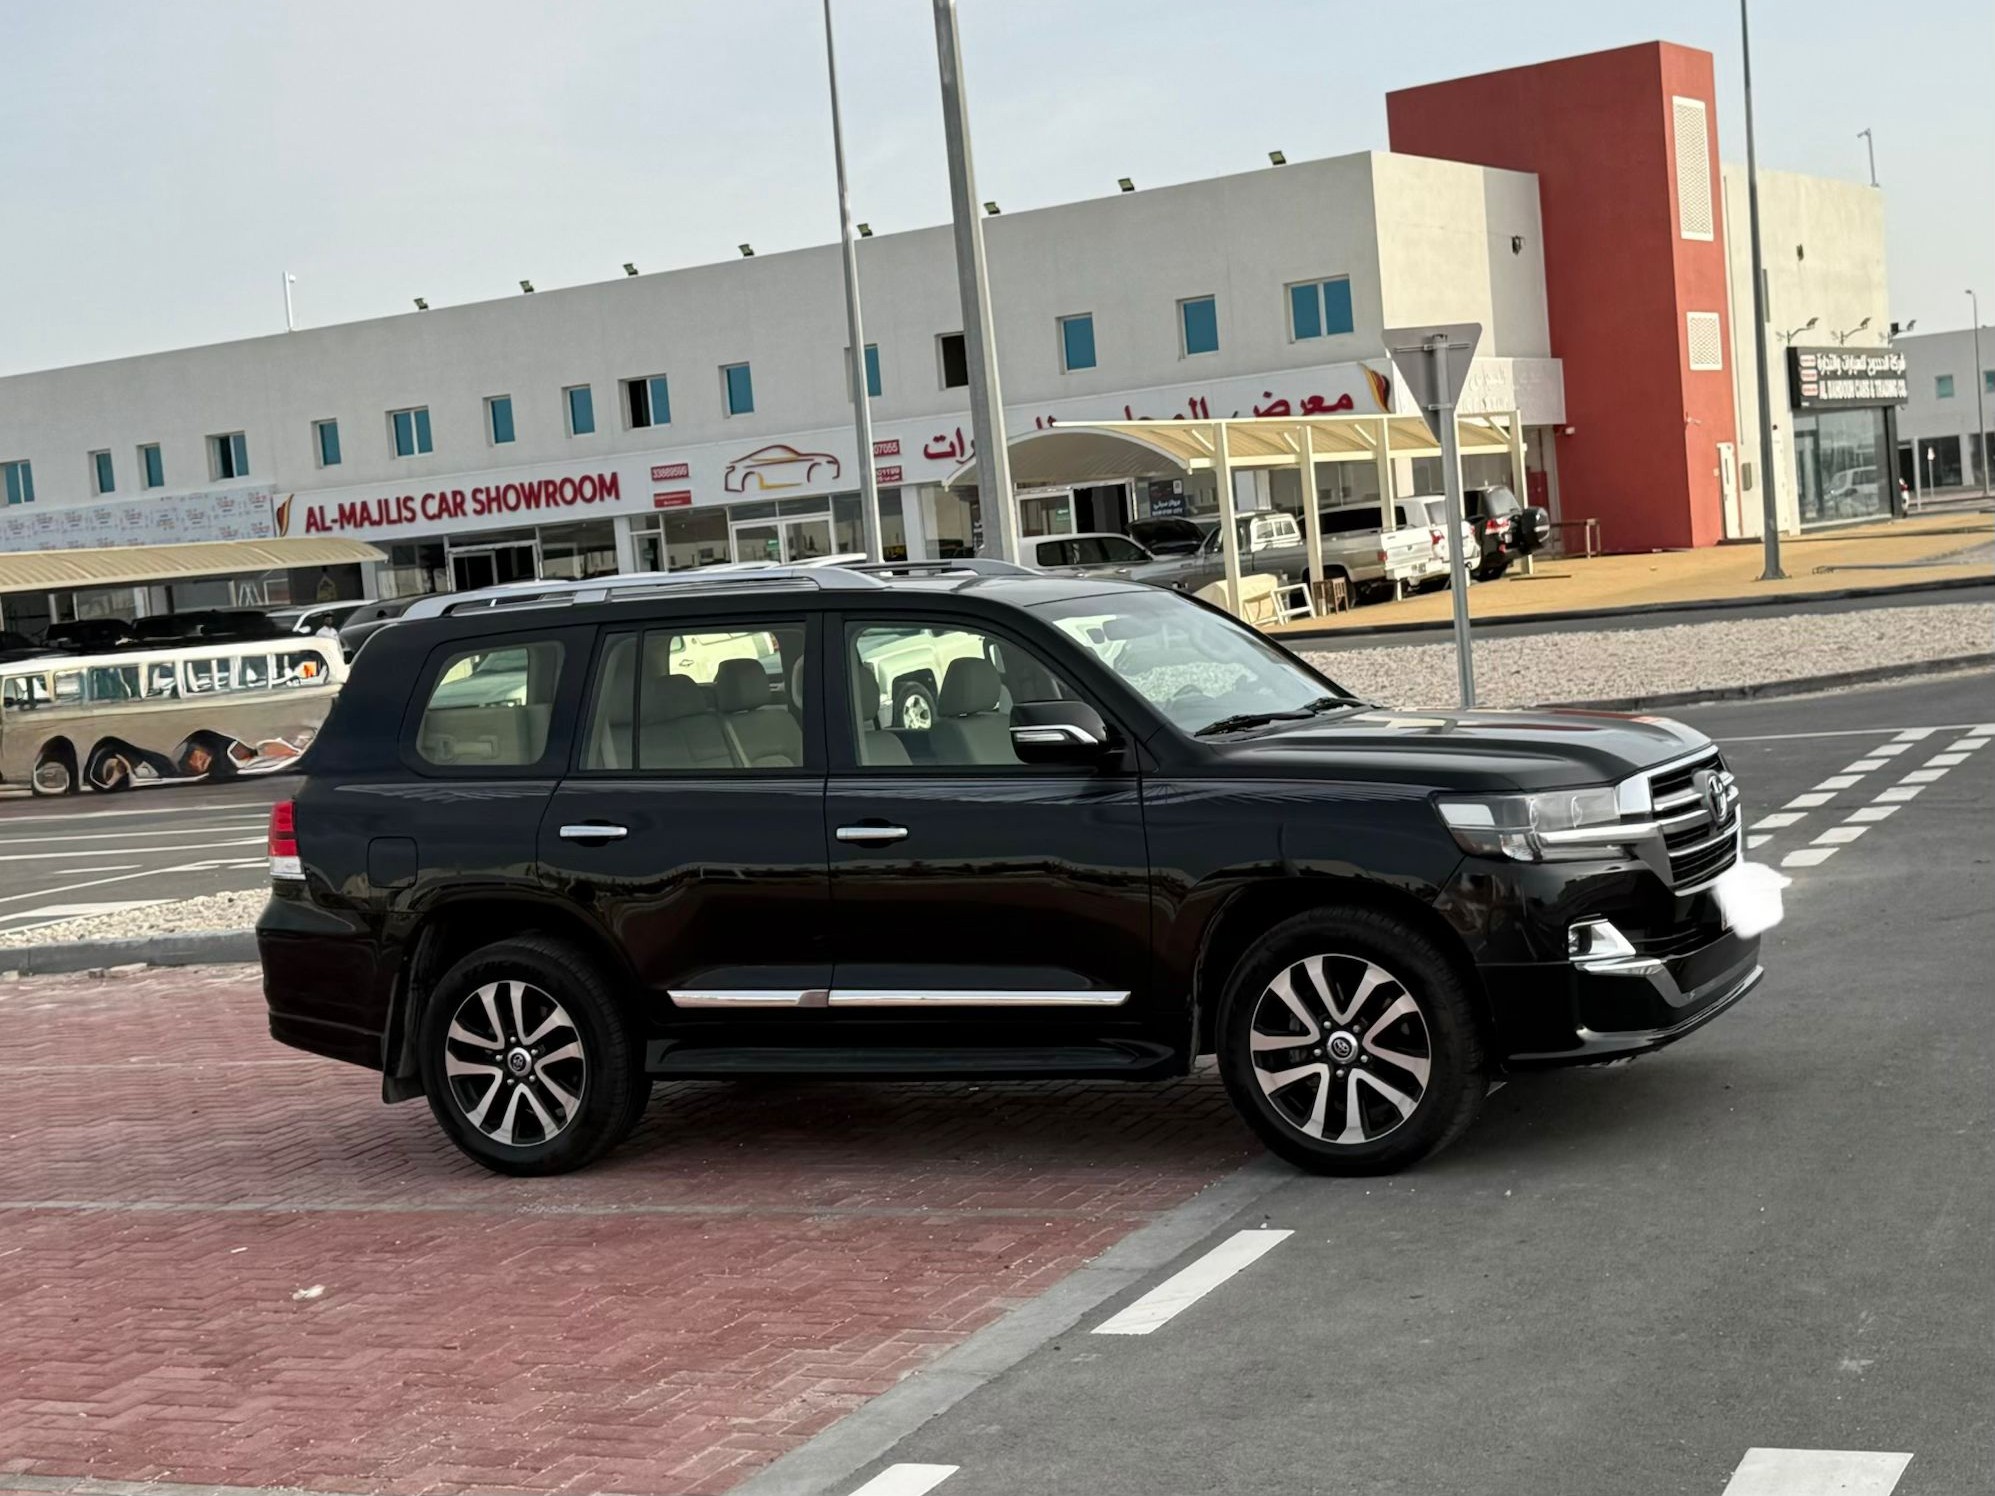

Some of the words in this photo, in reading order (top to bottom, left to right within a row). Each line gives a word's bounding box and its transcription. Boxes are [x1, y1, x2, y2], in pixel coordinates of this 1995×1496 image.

[305, 496, 416, 533] AL-MAJLIS
[421, 490, 467, 520] CAR
[471, 472, 620, 517] SHOWROOM
